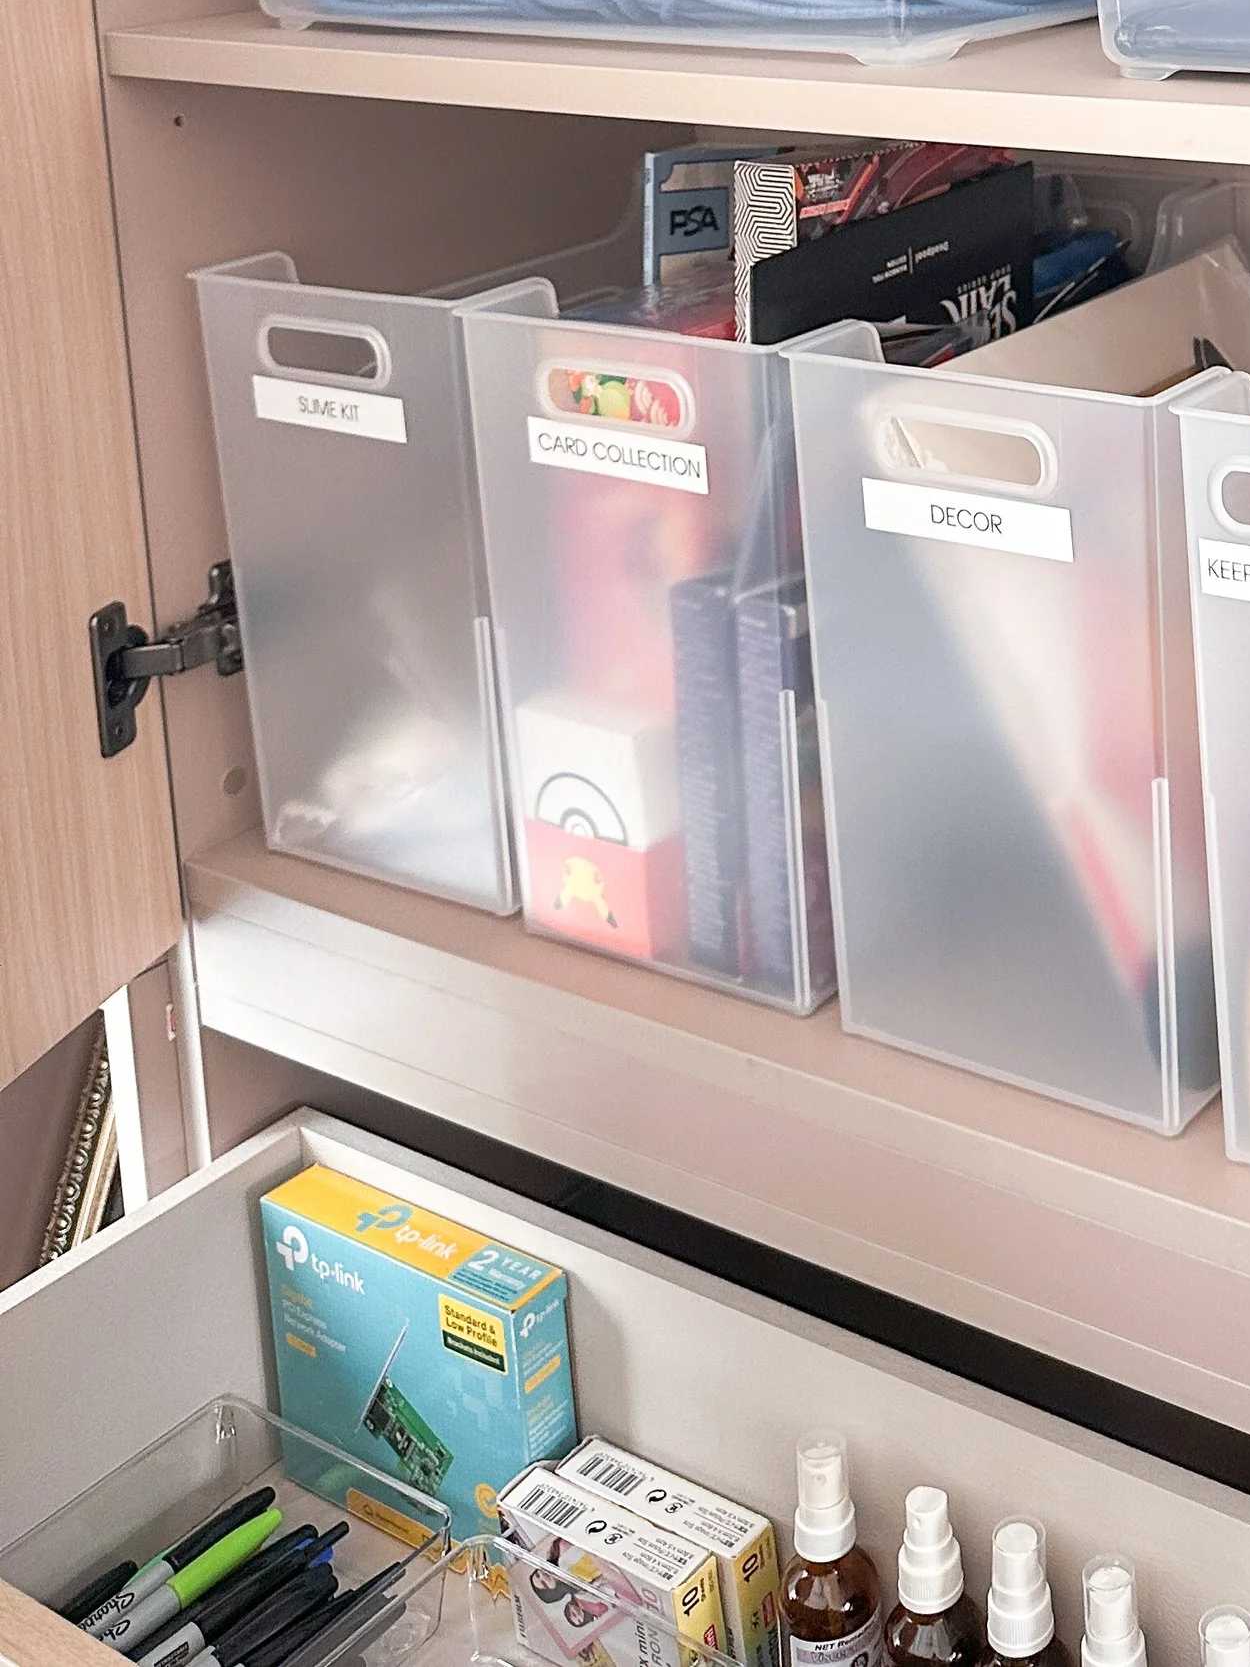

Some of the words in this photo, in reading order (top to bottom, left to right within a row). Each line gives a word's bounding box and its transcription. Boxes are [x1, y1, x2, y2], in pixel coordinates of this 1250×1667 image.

[669, 205, 719, 237] PSA
[298, 395, 338, 419] SLIME
[341, 403, 360, 422] KIT
[538, 432, 588, 457] CARD
[592, 441, 701, 479] COLLECTION
[930, 504, 1003, 536] DECOR
[394, 1224, 460, 1261] tp-link
[310, 1253, 366, 1296] tp-link
[467, 1249, 500, 1273] 2
[501, 1256, 543, 1281] YEAR
[443, 1304, 488, 1330] Standard
[487, 1323, 496, 1335] &
[445, 1316, 466, 1335] Low
[465, 1325, 498, 1348] Profile
[742, 1552, 760, 1583] 10
[79, 1592, 135, 1631] Sharp
[681, 1586, 701, 1617] 10
